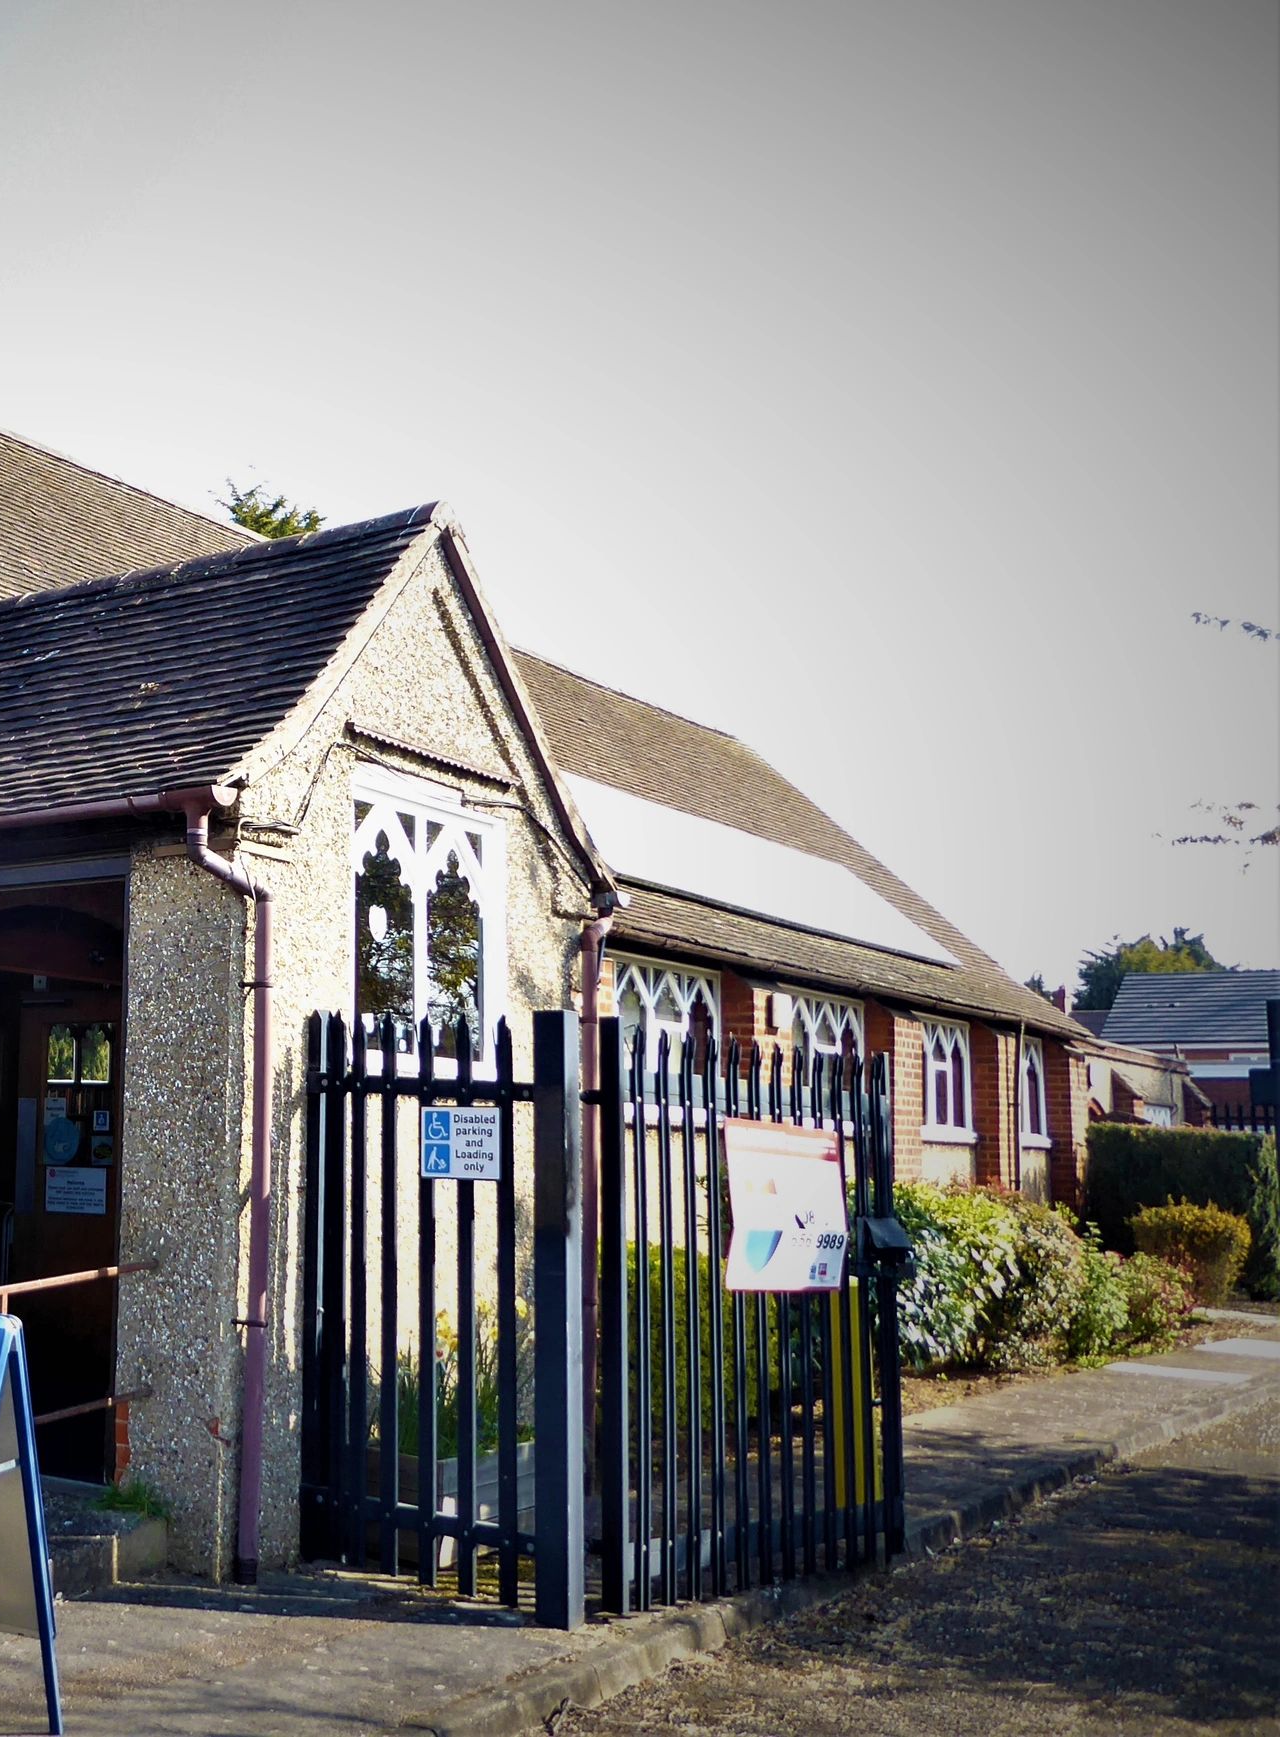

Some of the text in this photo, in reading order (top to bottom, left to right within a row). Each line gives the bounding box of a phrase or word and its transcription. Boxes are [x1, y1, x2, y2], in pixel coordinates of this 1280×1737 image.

[453, 1114, 496, 1124] Disabled
[455, 1126, 493, 1137] parking
[465, 1139, 483, 1147] and
[455, 1150, 494, 1161] Loading
[463, 1162, 485, 1172] only
[816, 1233, 845, 1249] 9989
